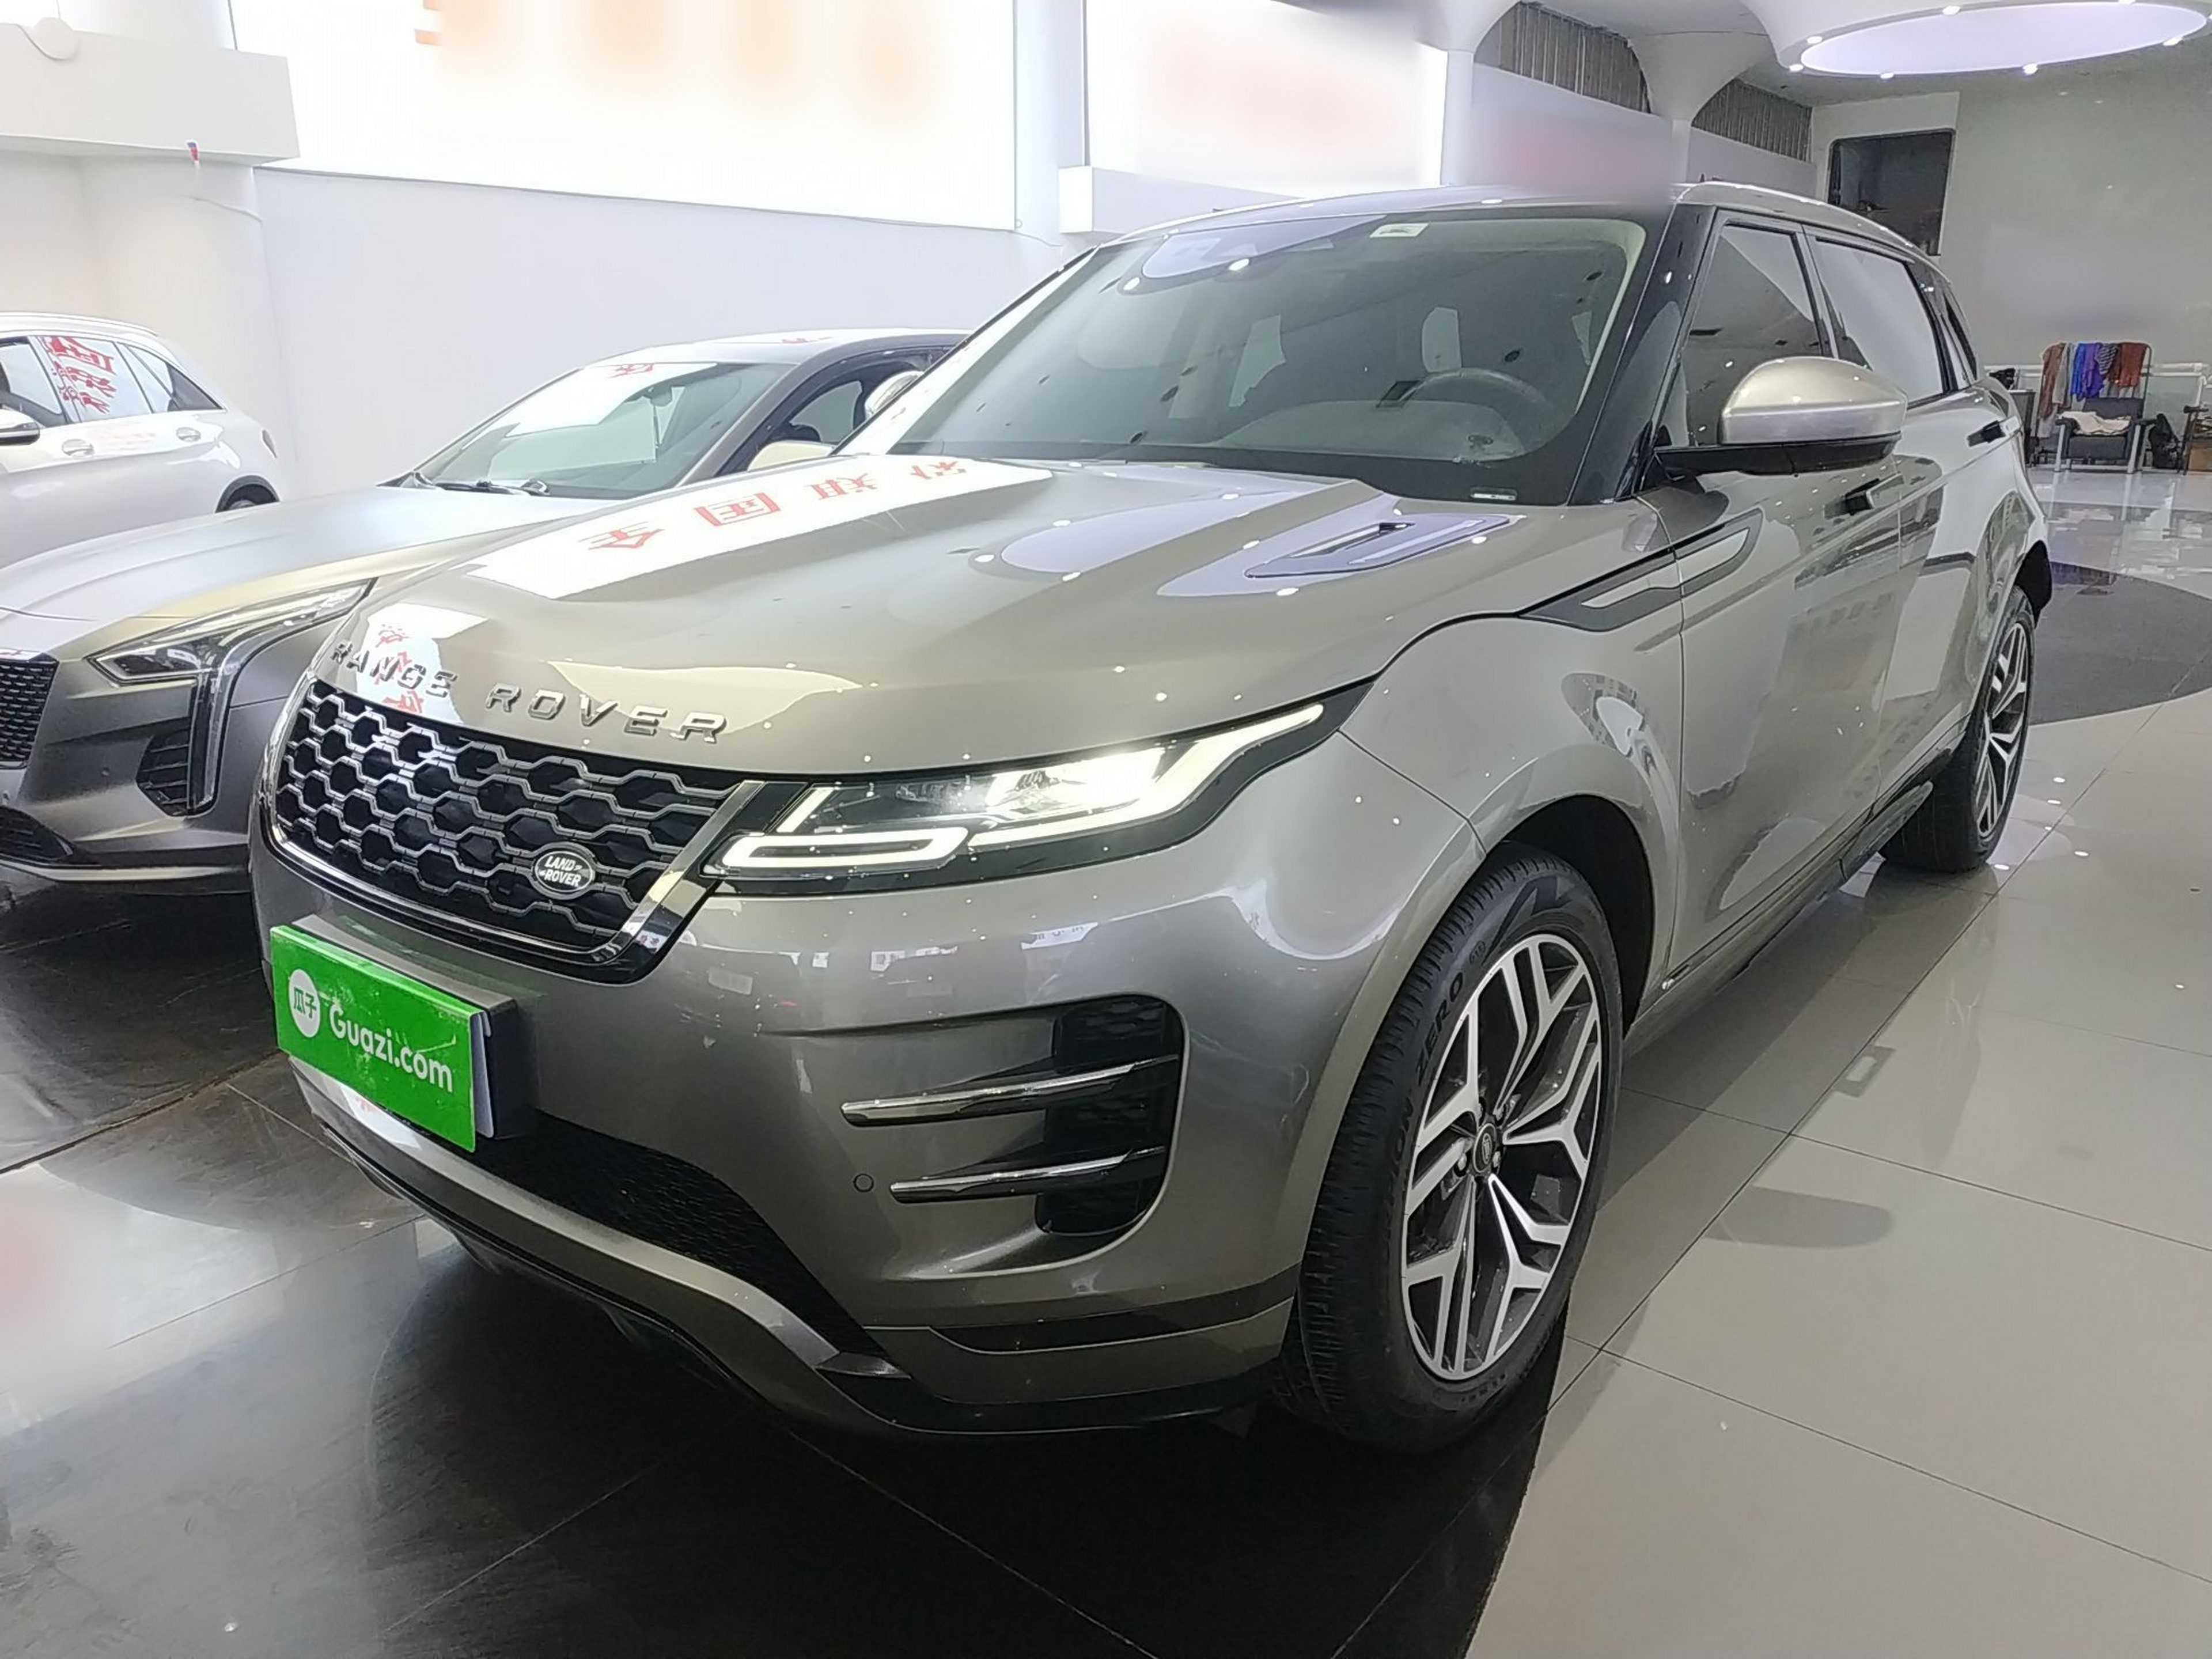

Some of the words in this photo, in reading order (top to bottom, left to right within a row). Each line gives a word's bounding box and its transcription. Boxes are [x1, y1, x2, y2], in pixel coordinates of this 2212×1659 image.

[330, 643, 458, 698] RANGE
[486, 683, 726, 744] ROVER
[544, 855, 576, 872] LAND
[544, 869, 582, 888] ROVER
[294, 987, 317, 1019] 瓜子
[1416, 972, 1463, 1086] ZERO
[329, 1002, 453, 1093] Guazi.com
